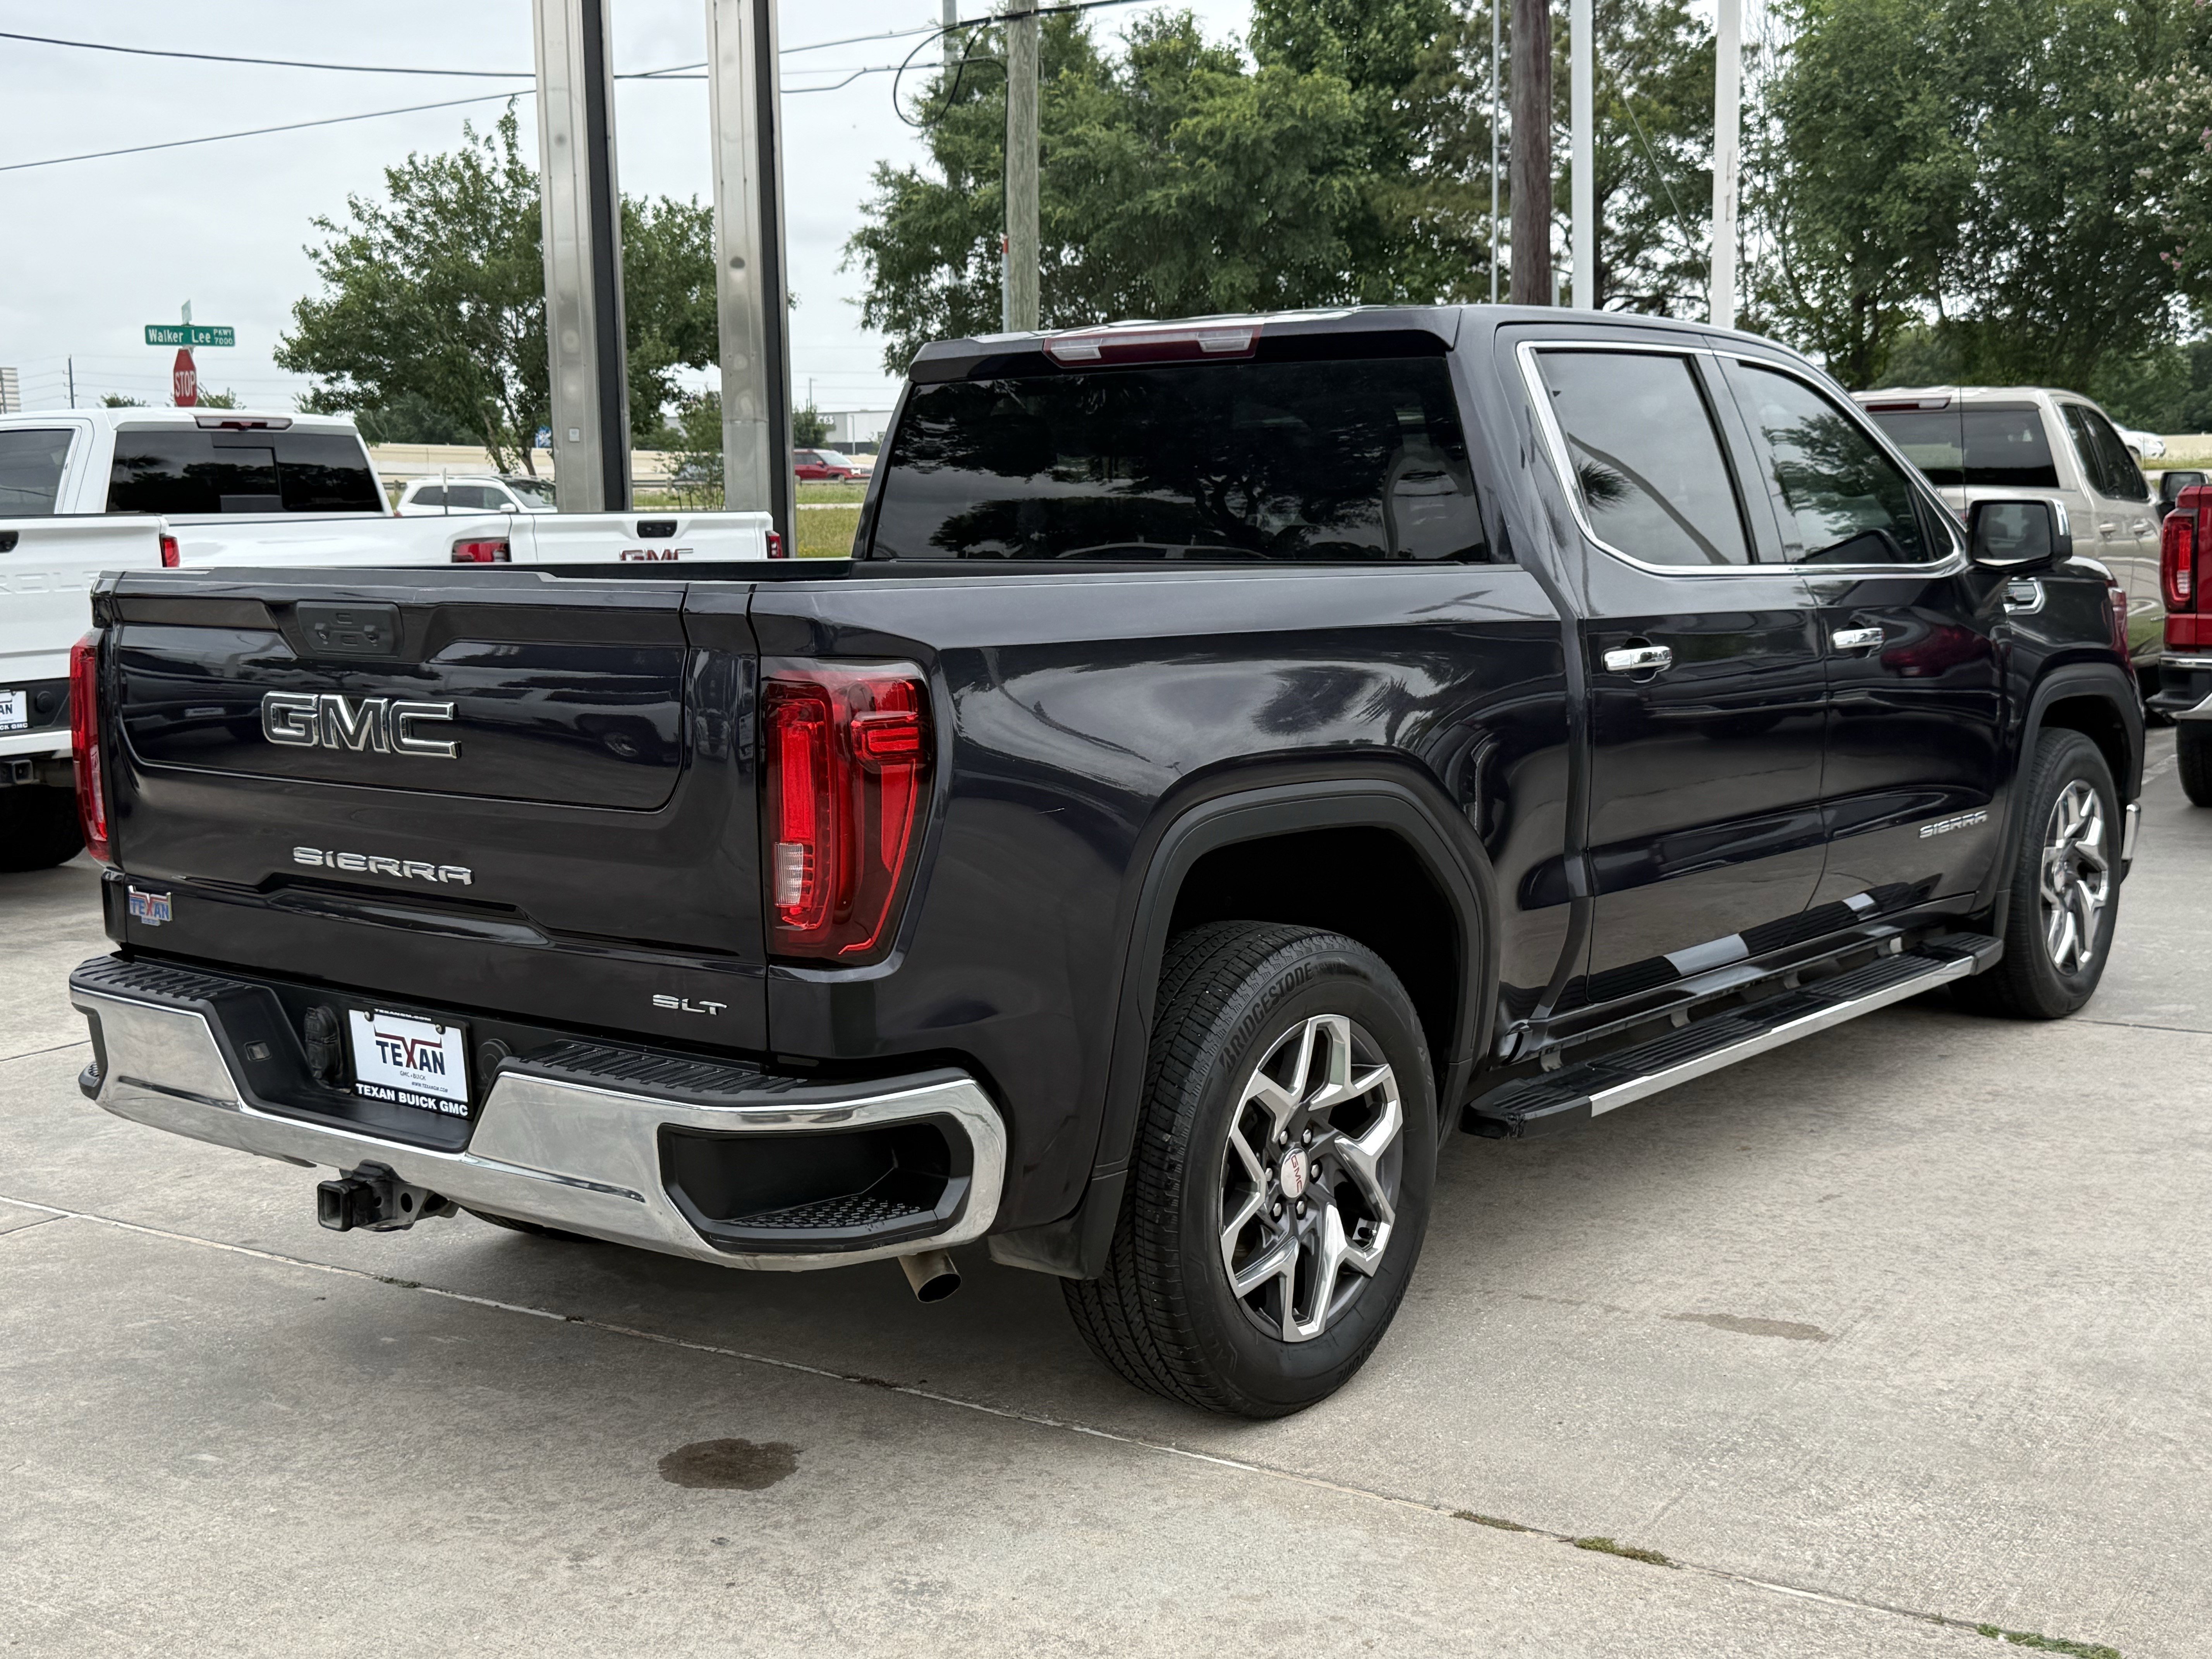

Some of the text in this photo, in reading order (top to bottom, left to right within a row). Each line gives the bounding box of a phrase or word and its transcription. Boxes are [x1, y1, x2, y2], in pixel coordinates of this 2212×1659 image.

[149, 329, 211, 343] Walker Lee
[175, 371, 196, 398] STOP
[261, 691, 462, 759] GMC
[1920, 810, 1988, 839] SIERRA
[293, 846, 475, 885] SIERRA
[129, 894, 170, 920] TEXAN
[653, 994, 727, 1015] SLT
[1218, 961, 1314, 1075] BRIDGESTONE
[376, 1038, 445, 1075] TEXAN
[356, 1083, 468, 1116] TEXAN BUICK GMC
[1291, 1154, 1303, 1193] GMC
